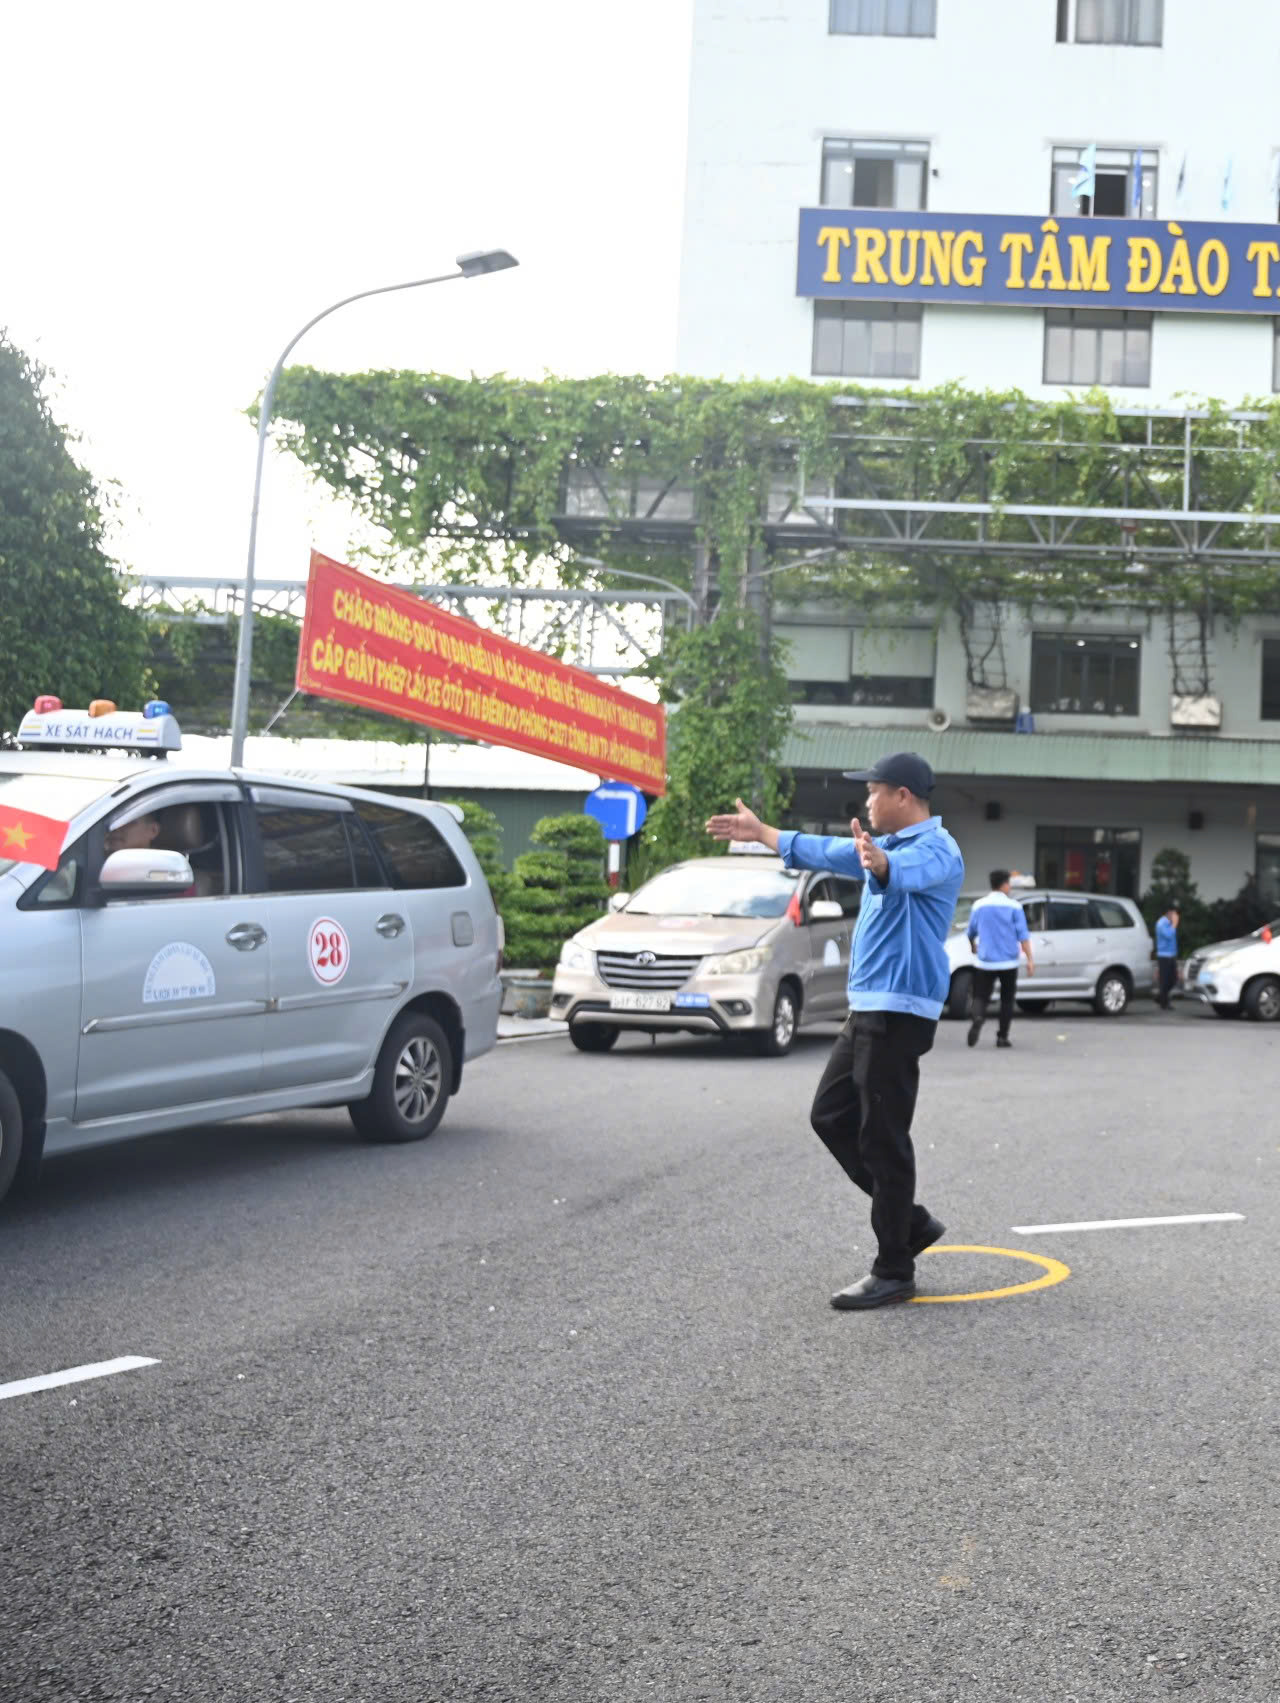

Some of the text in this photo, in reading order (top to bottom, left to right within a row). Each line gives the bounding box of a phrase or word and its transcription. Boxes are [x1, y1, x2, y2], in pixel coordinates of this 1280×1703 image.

[819, 228, 987, 286] TRUNG
[1001, 220, 1113, 292] TÂM
[1127, 223, 1229, 297] ĐÀO
[333, 589, 374, 630] CHÀO
[374, 602, 413, 645] MỪNG
[311, 627, 345, 676] CẤP
[345, 639, 377, 686] GIẤY
[376, 656, 407, 696] PHÉP
[427, 677, 442, 707] XE
[45, 725, 61, 737] XE
[65, 721, 88, 738] SÁT
[315, 932, 343, 967] 28
